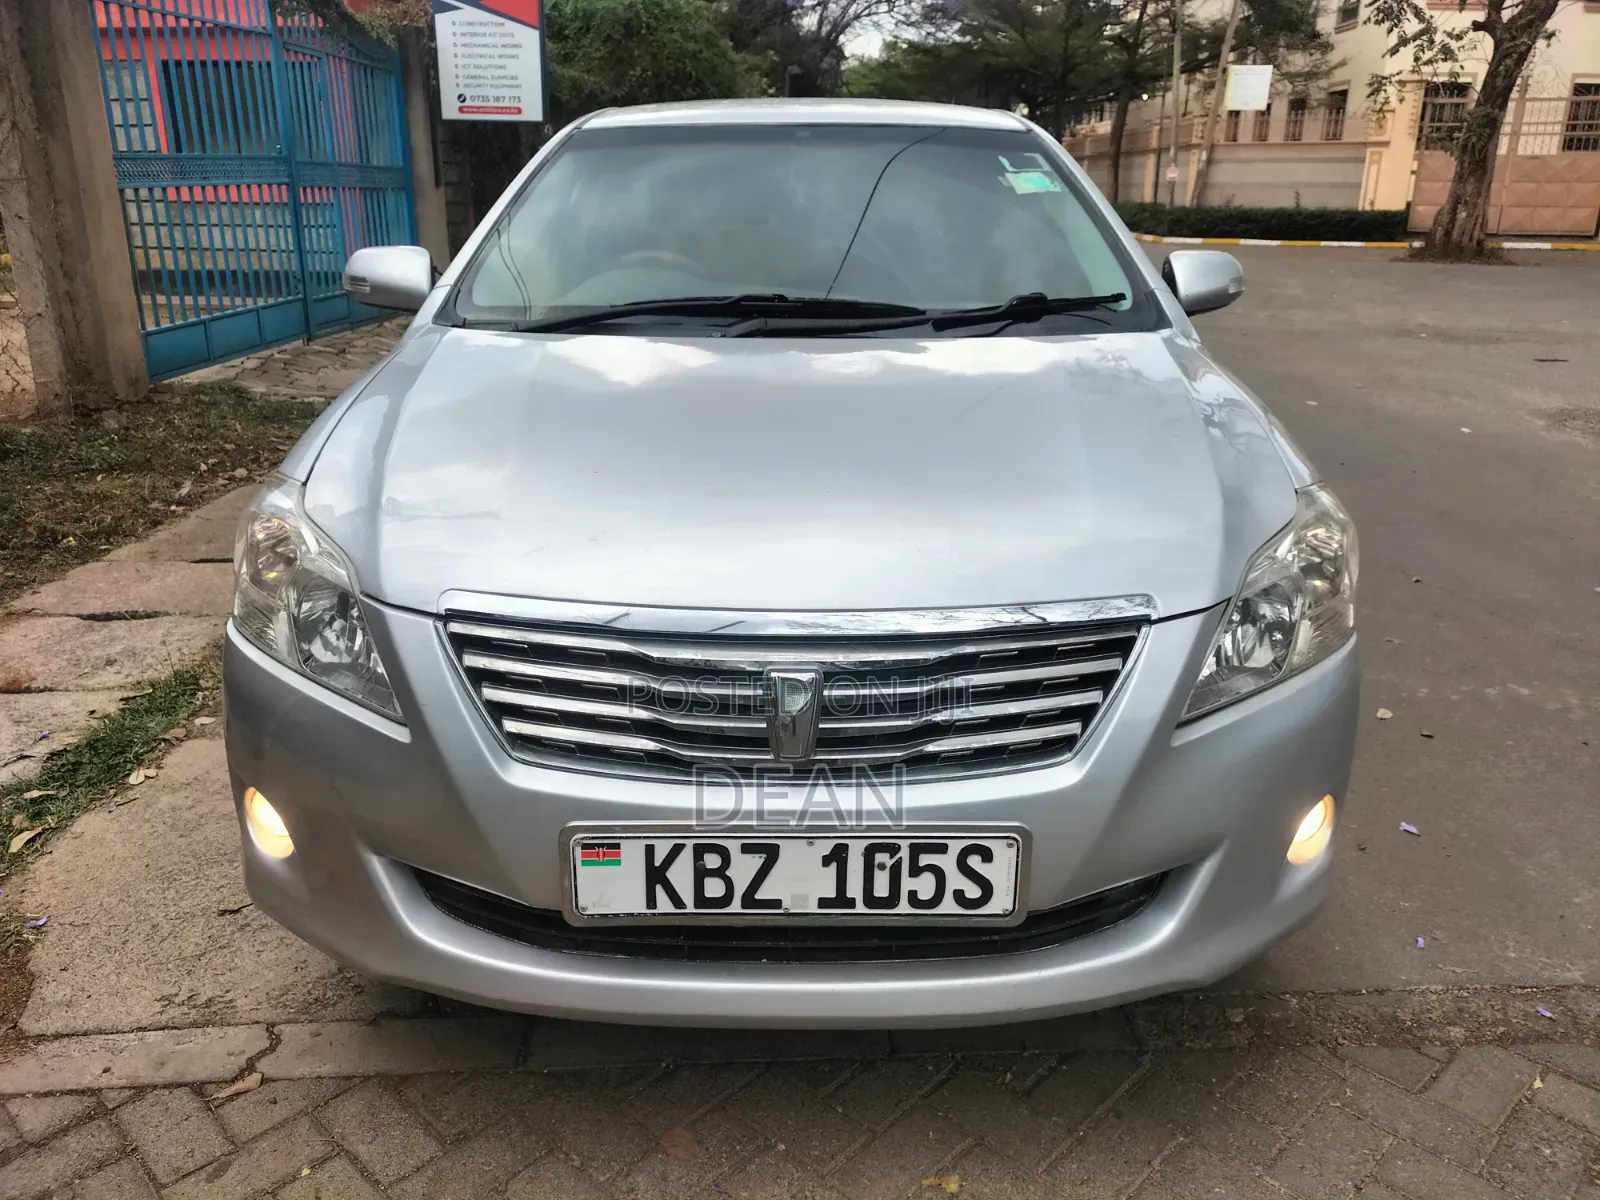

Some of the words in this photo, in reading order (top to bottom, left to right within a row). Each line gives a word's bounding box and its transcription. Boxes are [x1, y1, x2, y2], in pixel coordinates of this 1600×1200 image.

[470, 95, 490, 103] 0735
[492, 95, 506, 103] 187
[644, 842, 784, 910] KBZ
[817, 842, 994, 910] 105S
